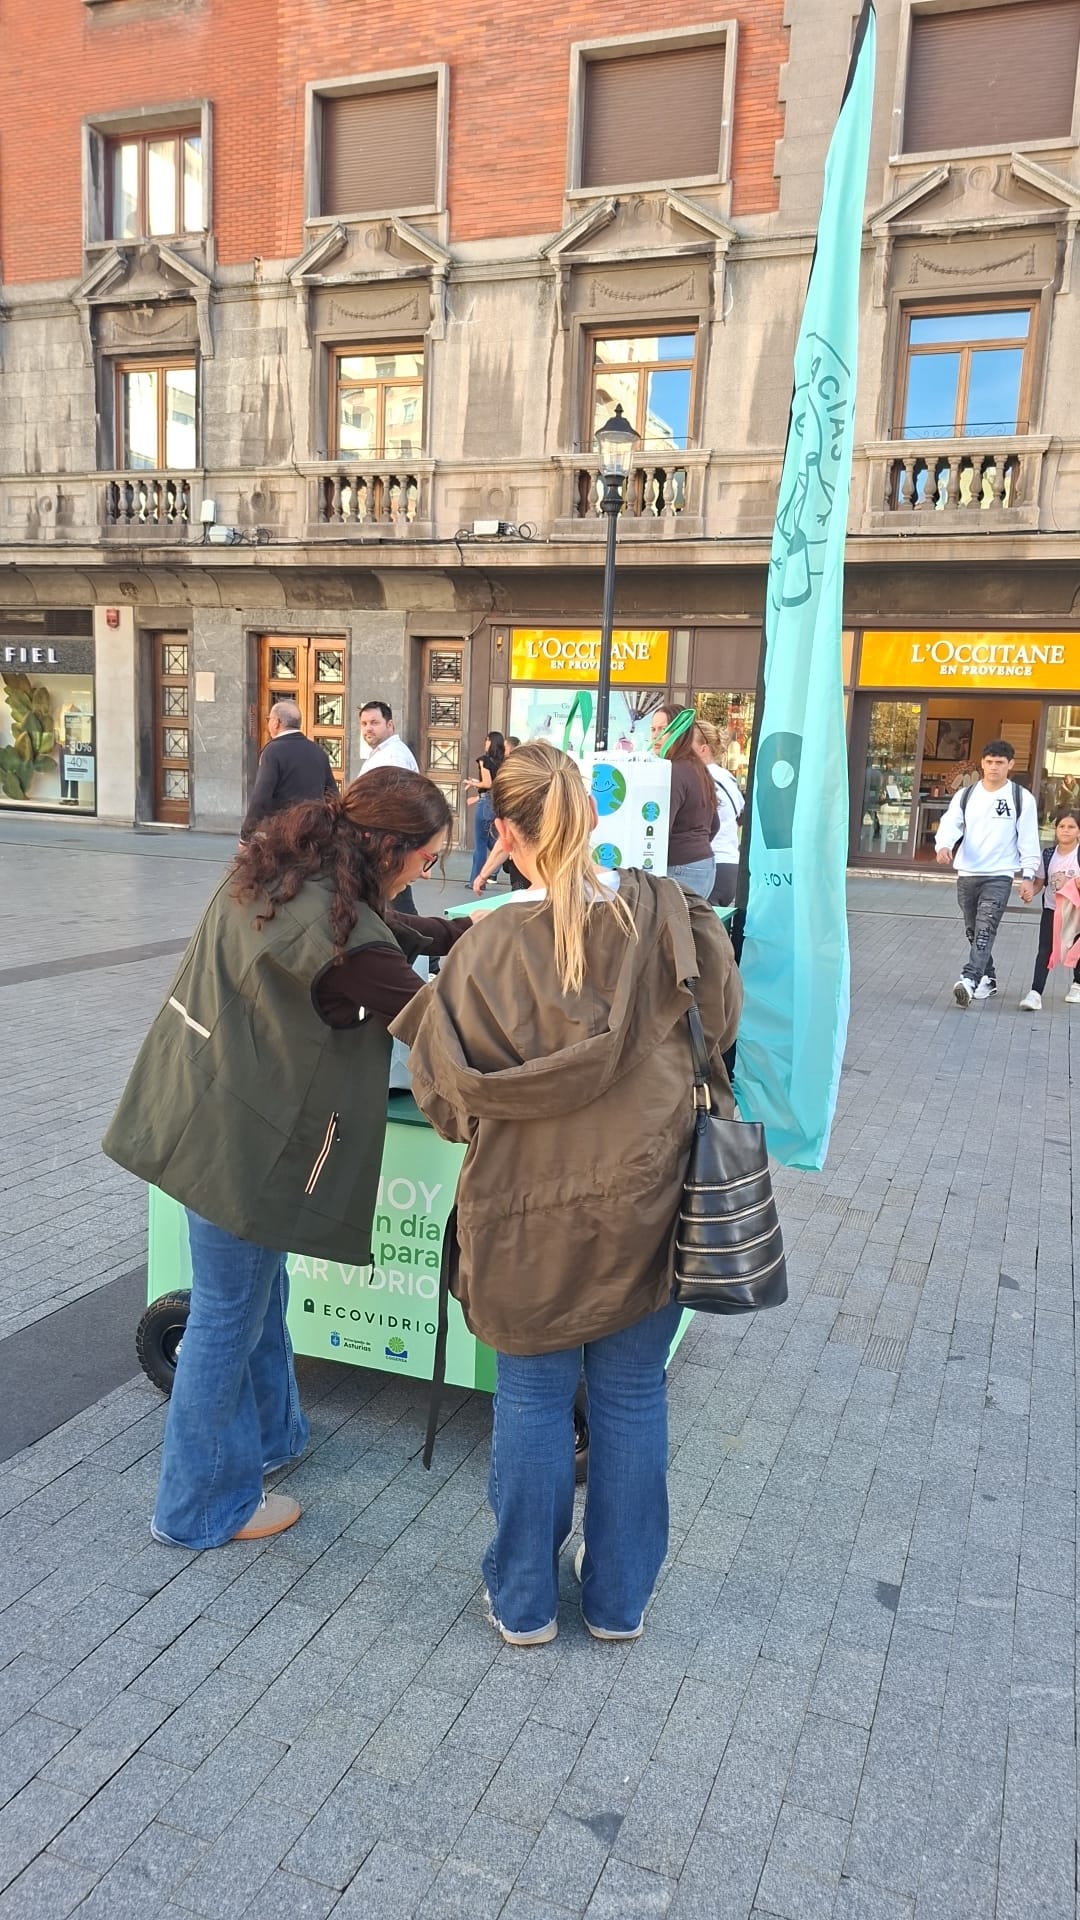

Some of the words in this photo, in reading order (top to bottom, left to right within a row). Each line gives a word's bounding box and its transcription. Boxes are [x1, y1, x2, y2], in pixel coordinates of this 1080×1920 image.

[5, 646, 60, 664] FIEL
[527, 637, 650, 660] L'OCCIANE
[911, 640, 1066, 664] L'OCCITANE
[550, 659, 565, 670] EN
[568, 660, 625, 671] PROVCE
[939, 665, 957, 676] EN
[961, 666, 1033, 677] PROVENCE
[399, 1213, 441, 1242] día
[380, 1242, 440, 1269] para
[337, 1262, 440, 1299] VIDRIO
[323, 1304, 436, 1335] ECOVIDRIO
[343, 1341, 372, 1352] Asturias
